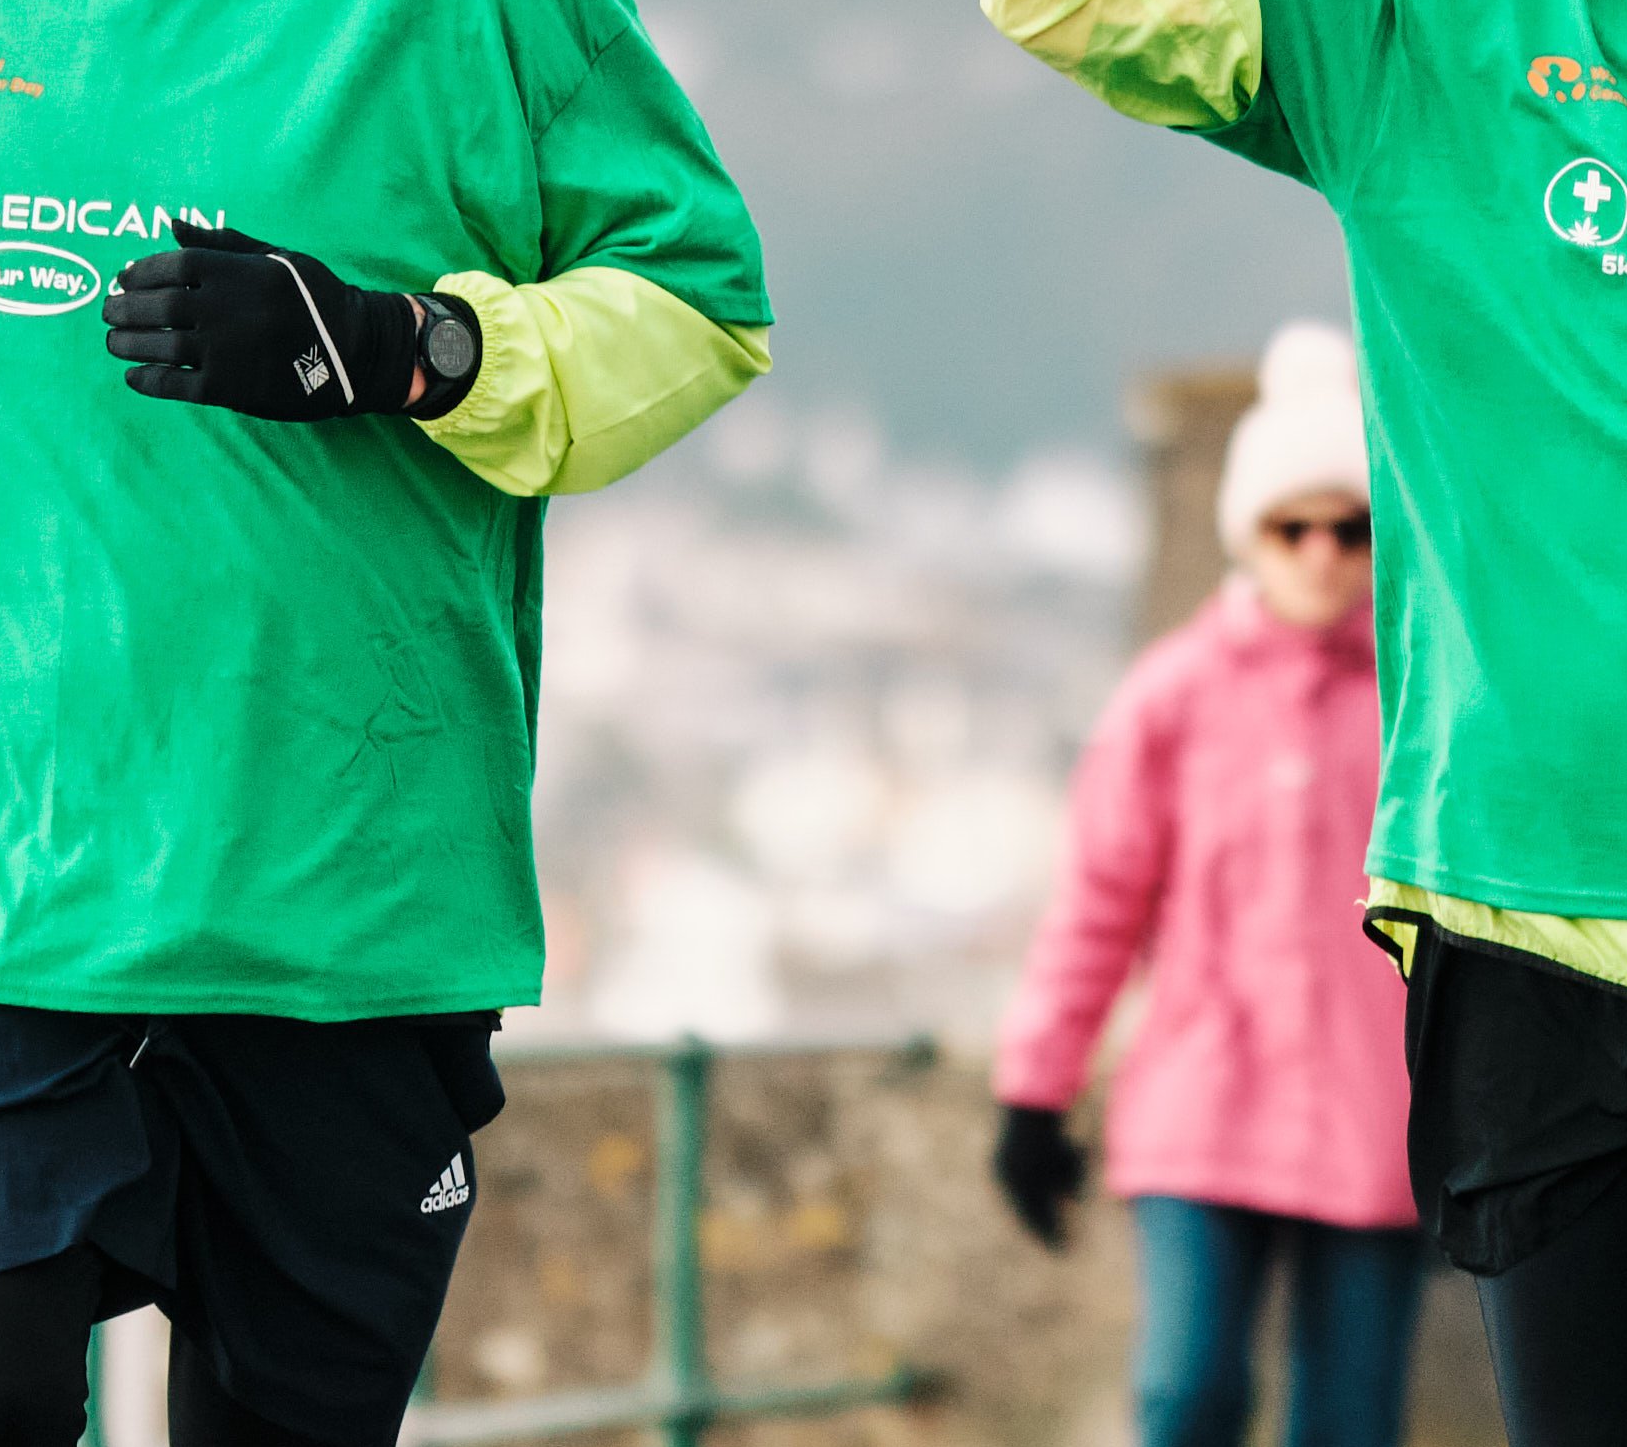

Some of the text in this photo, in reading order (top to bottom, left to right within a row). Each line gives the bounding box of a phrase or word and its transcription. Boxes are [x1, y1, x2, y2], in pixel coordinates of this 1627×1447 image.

[10, 77, 44, 98] Day
[30, 267, 88, 297] Way.
[420, 1185, 470, 1214] adidas
